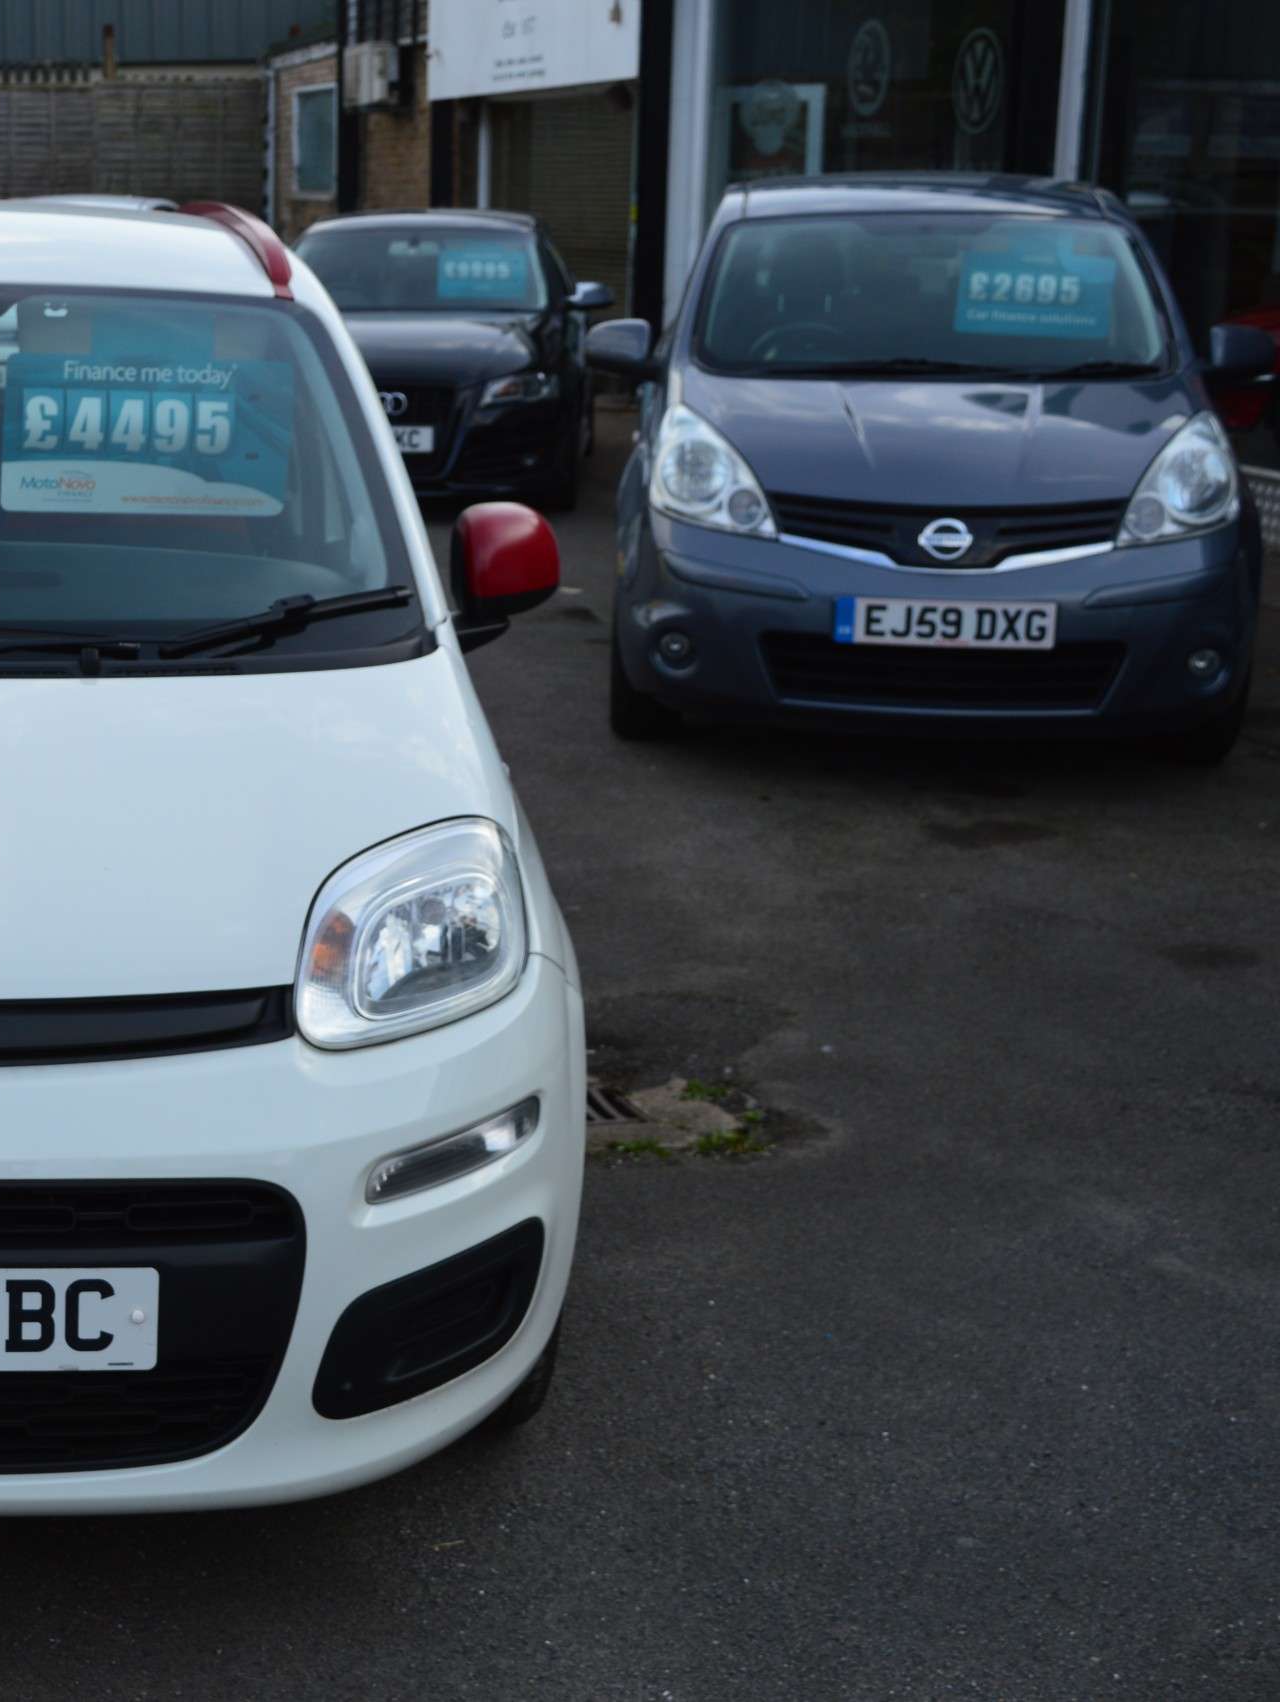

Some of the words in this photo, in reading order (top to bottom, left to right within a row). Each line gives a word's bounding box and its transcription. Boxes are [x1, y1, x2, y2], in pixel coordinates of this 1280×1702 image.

[969, 271, 1080, 304] £2695
[63, 360, 136, 383] Finance
[141, 368, 172, 382] me
[23, 395, 231, 454] £4495
[20, 476, 97, 491] MotoNovo
[864, 604, 963, 640] EJ59
[974, 609, 1047, 643] DXG
